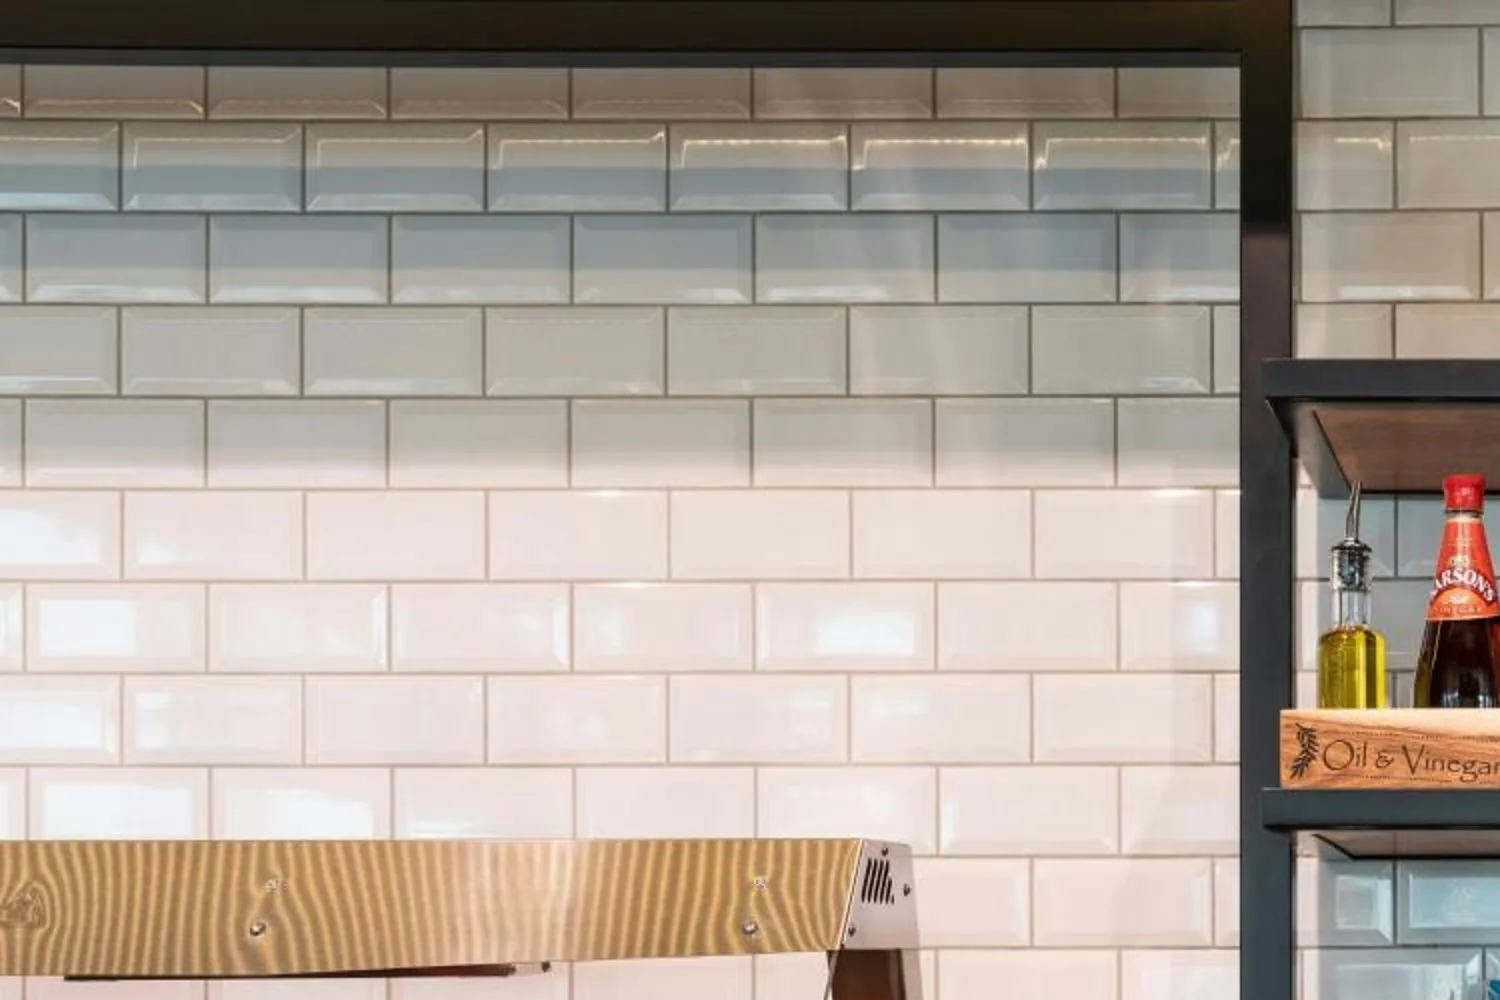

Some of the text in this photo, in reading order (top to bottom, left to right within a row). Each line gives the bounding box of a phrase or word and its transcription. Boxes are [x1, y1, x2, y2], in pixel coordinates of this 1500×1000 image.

[1430, 567, 1494, 602] ARSON'S
[1323, 739, 1368, 771] Oil
[1375, 755, 1395, 769] &
